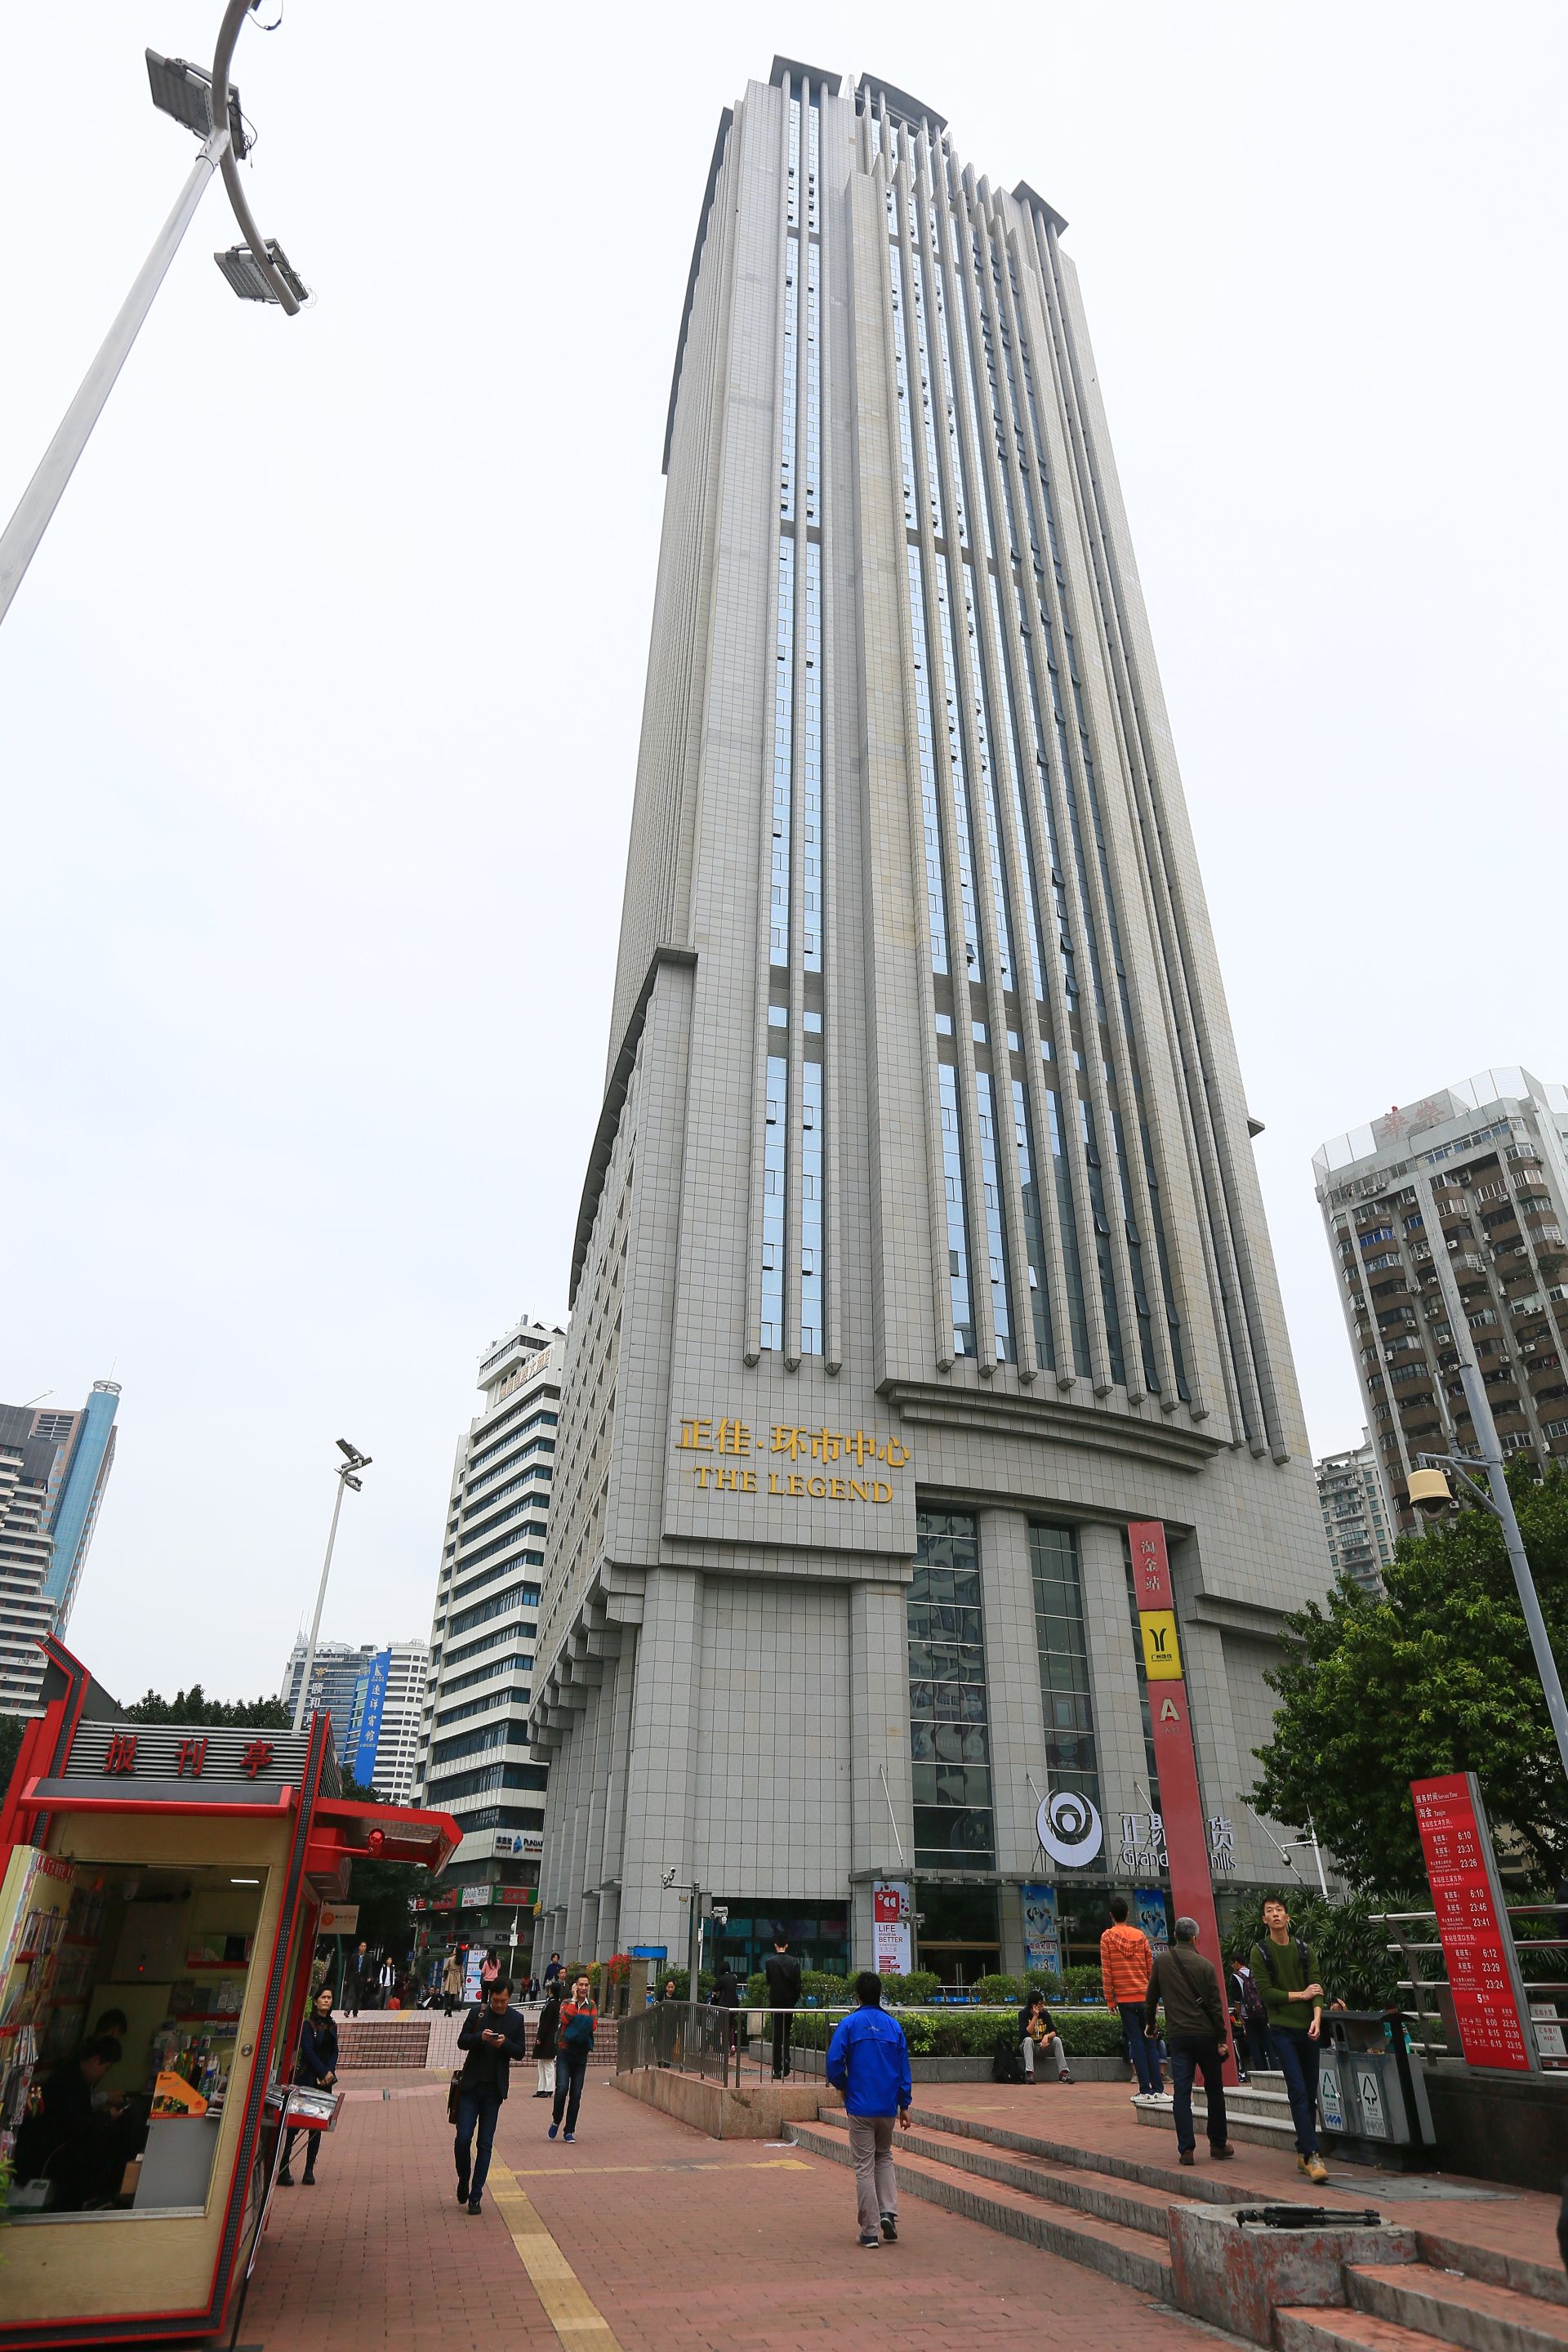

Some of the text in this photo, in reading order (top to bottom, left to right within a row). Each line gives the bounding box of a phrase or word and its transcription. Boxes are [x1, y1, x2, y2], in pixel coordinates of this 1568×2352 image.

[693, 1466, 893, 1503] THE LEGEND
[1140, 1540, 1160, 1591] 淘金站
[1160, 1698, 1180, 1721] A
[103, 1733, 274, 1778] 报刊亭
[1416, 1793, 1438, 1803] 服务时间
[1419, 1806, 1432, 1818] 淘金
[1457, 1831, 1472, 1841] 6:10
[1457, 1844, 1474, 1854] 23:31
[1460, 1859, 1477, 1868] 23:26
[1470, 1889, 1484, 1898] 6:10
[1470, 1903, 1487, 1912] 23:46
[1472, 1918, 1490, 1927] 23:41
[878, 1924, 896, 1932] LIFE
[1482, 1949, 1497, 1958] 6:12
[1481, 1962, 1500, 1972] 23:29
[1485, 1980, 1503, 1989] 23:24
[1502, 2020, 1517, 2028] 22:55
[1488, 2029, 1500, 2037] 6:15
[1504, 2030, 1520, 2038] 23:30
[1507, 2041, 1522, 2049] 23:15
